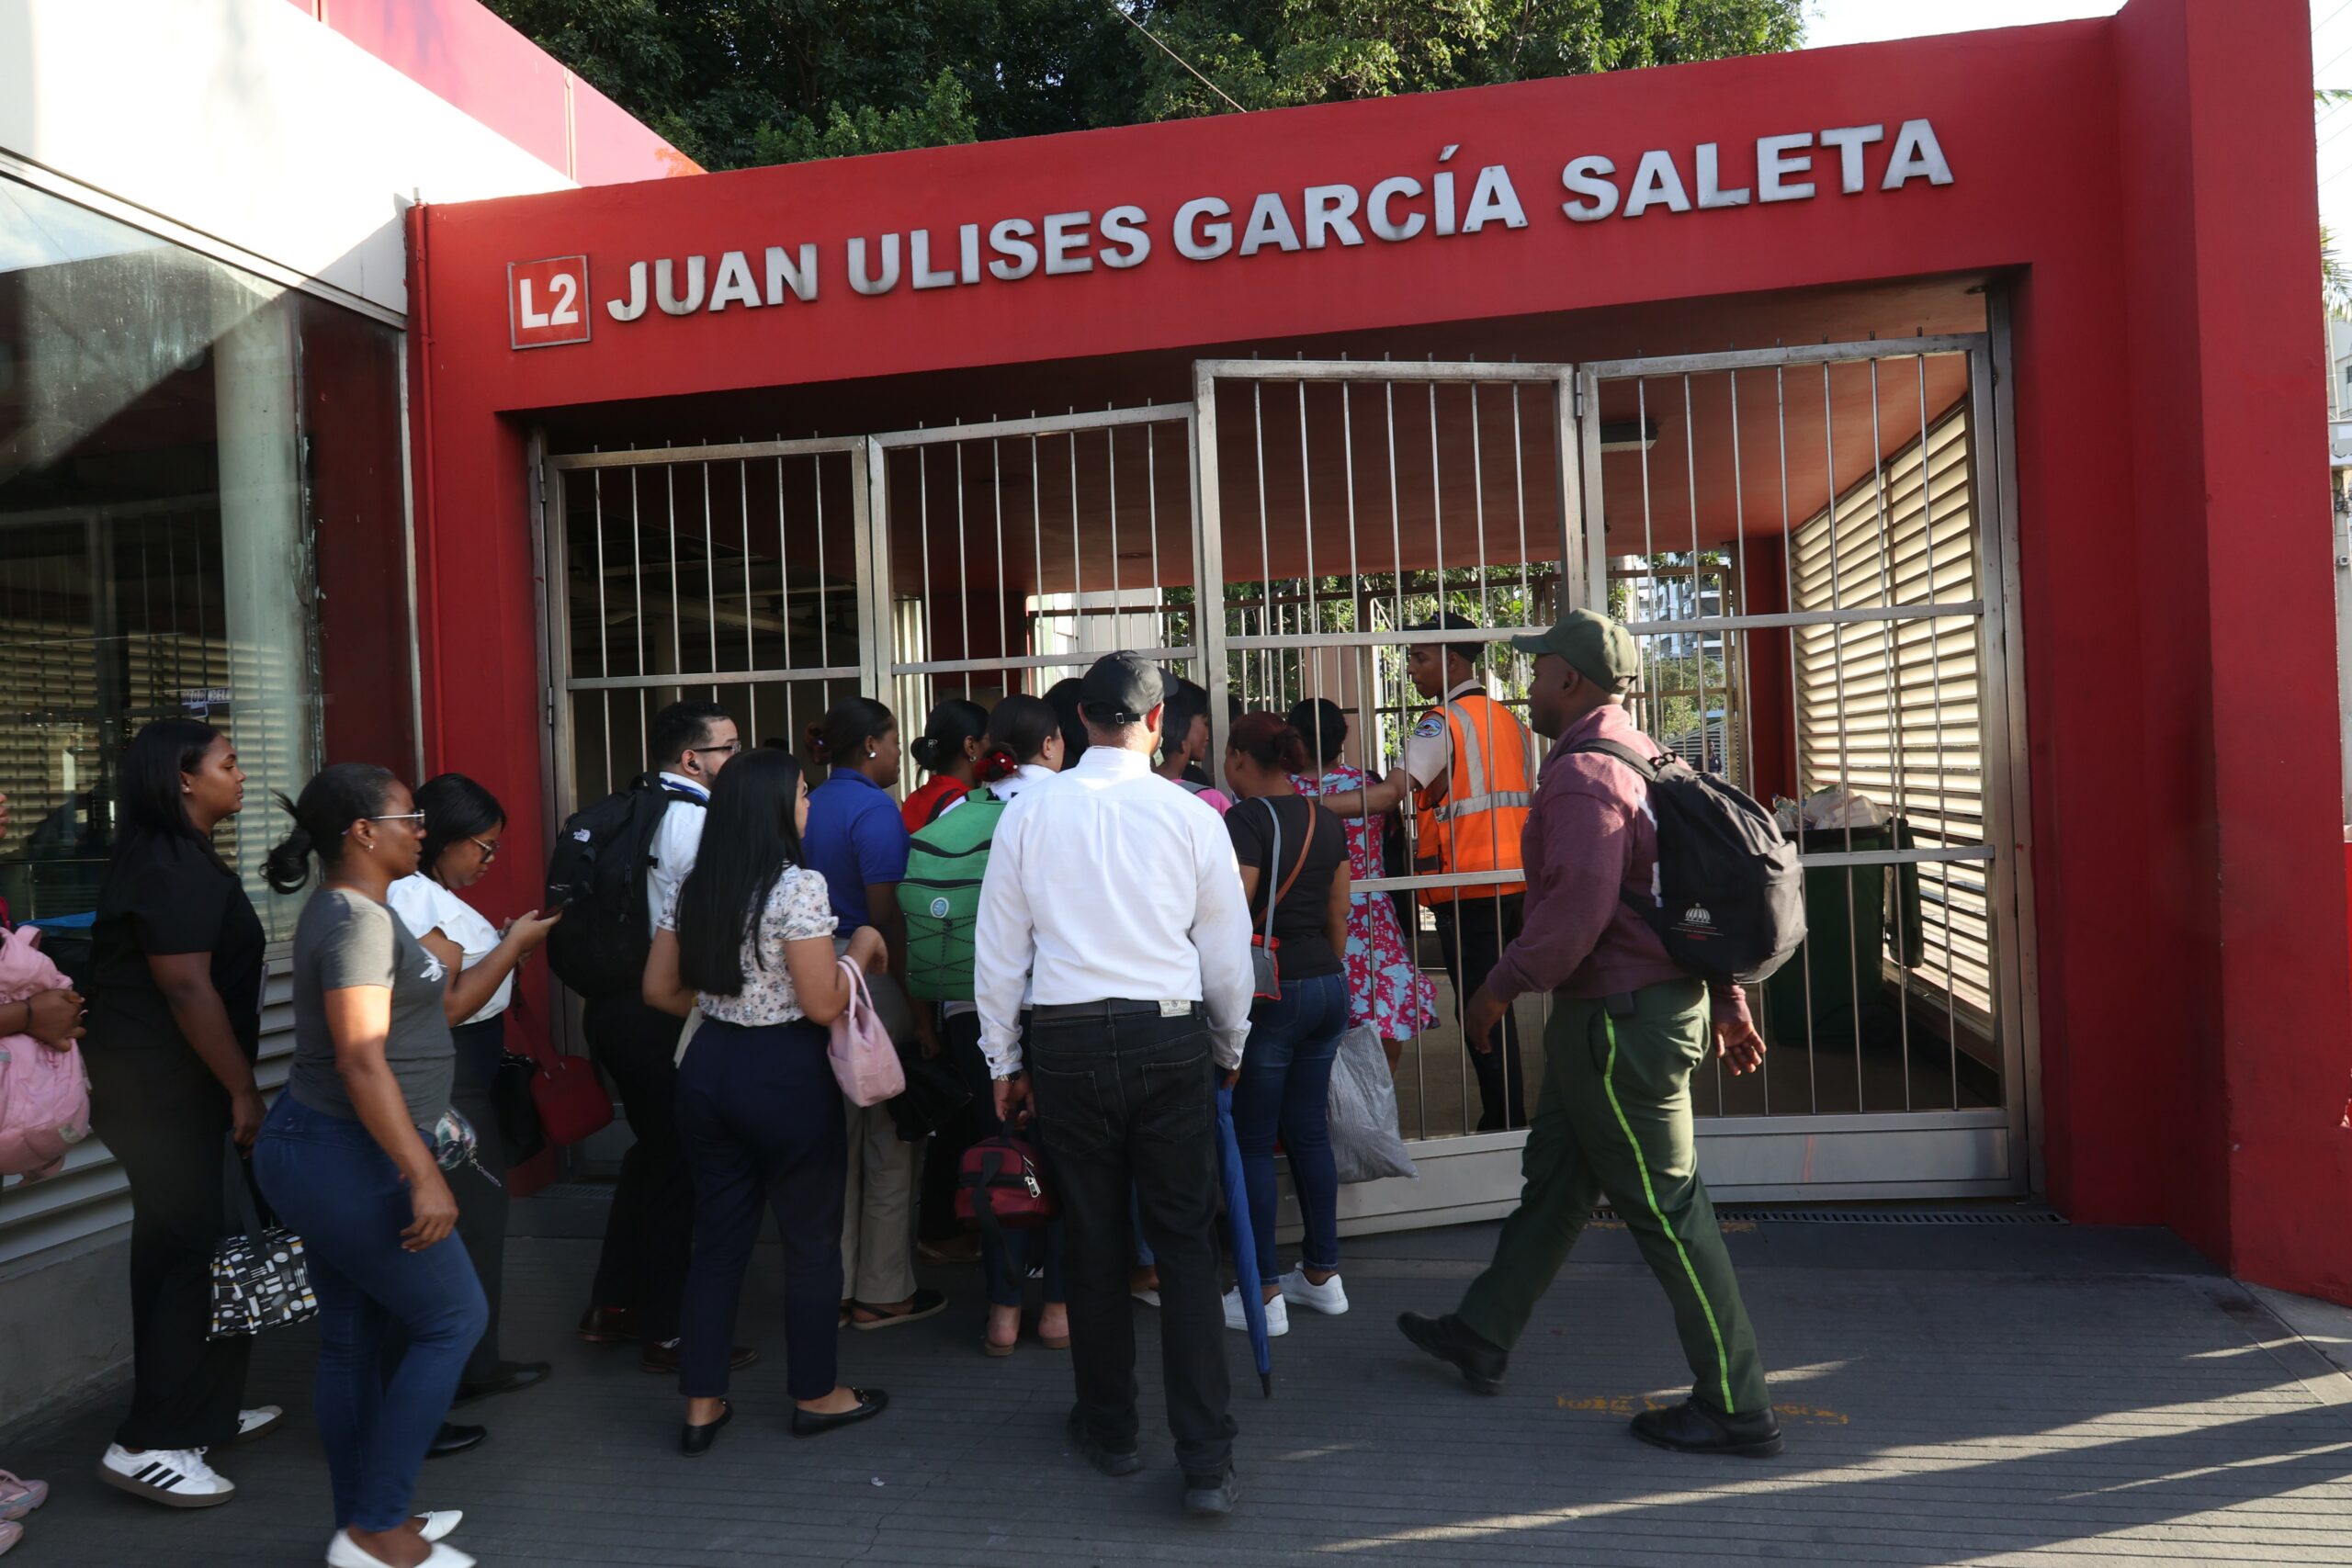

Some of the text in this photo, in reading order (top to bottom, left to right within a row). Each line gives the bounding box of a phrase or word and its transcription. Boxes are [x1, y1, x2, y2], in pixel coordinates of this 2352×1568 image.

[606, 118, 1955, 321] JUAN ULISES GARCÍA SALETA
[519, 274, 579, 329] L2
